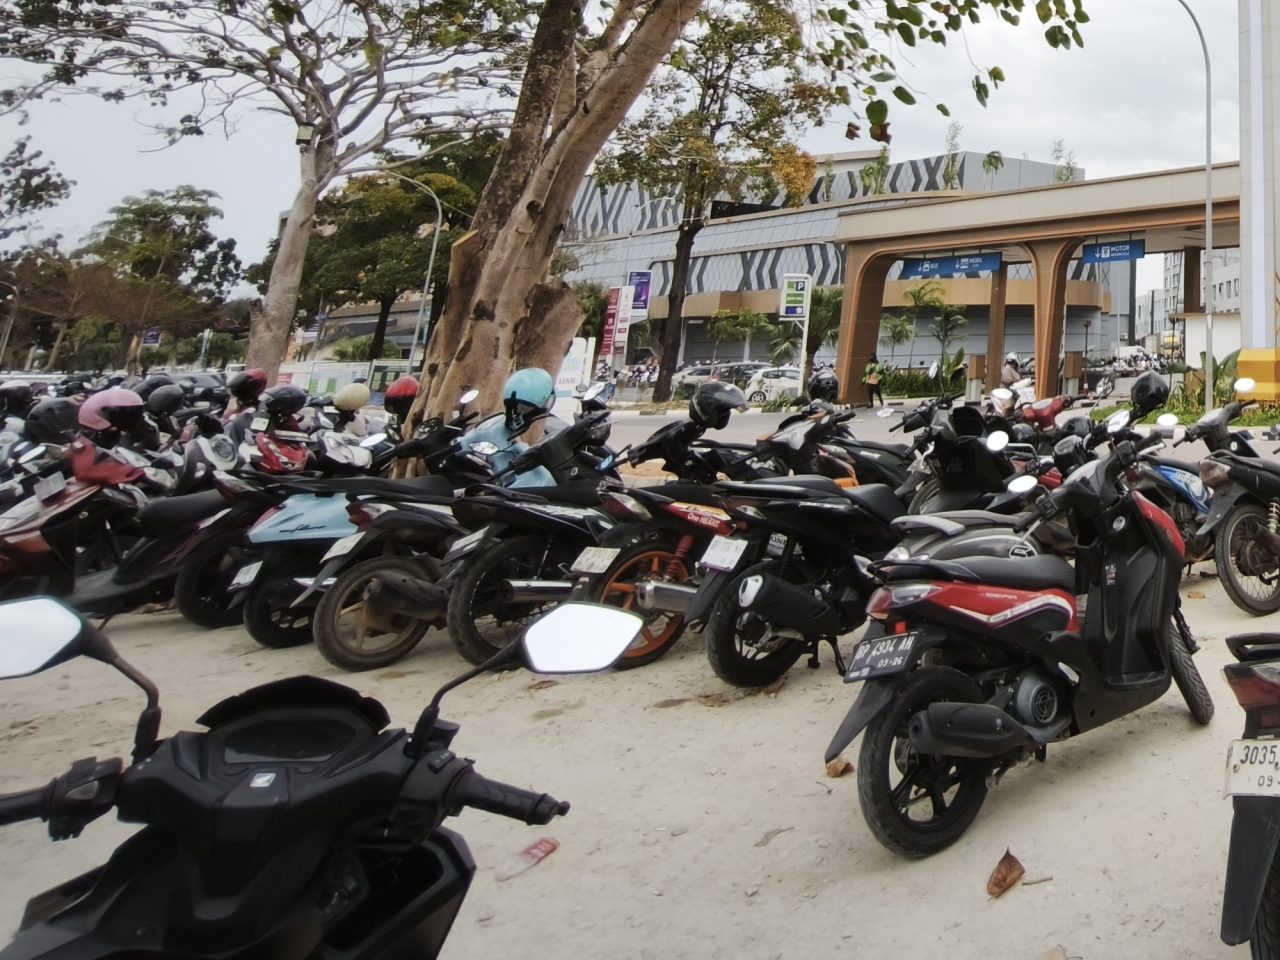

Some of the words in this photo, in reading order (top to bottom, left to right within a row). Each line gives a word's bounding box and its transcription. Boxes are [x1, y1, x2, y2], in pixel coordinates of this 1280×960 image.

[699, 516, 721, 528] HEART
[855, 643, 871, 660] BP
[897, 635, 915, 651] AH
[1240, 744, 1278, 765] 3035
